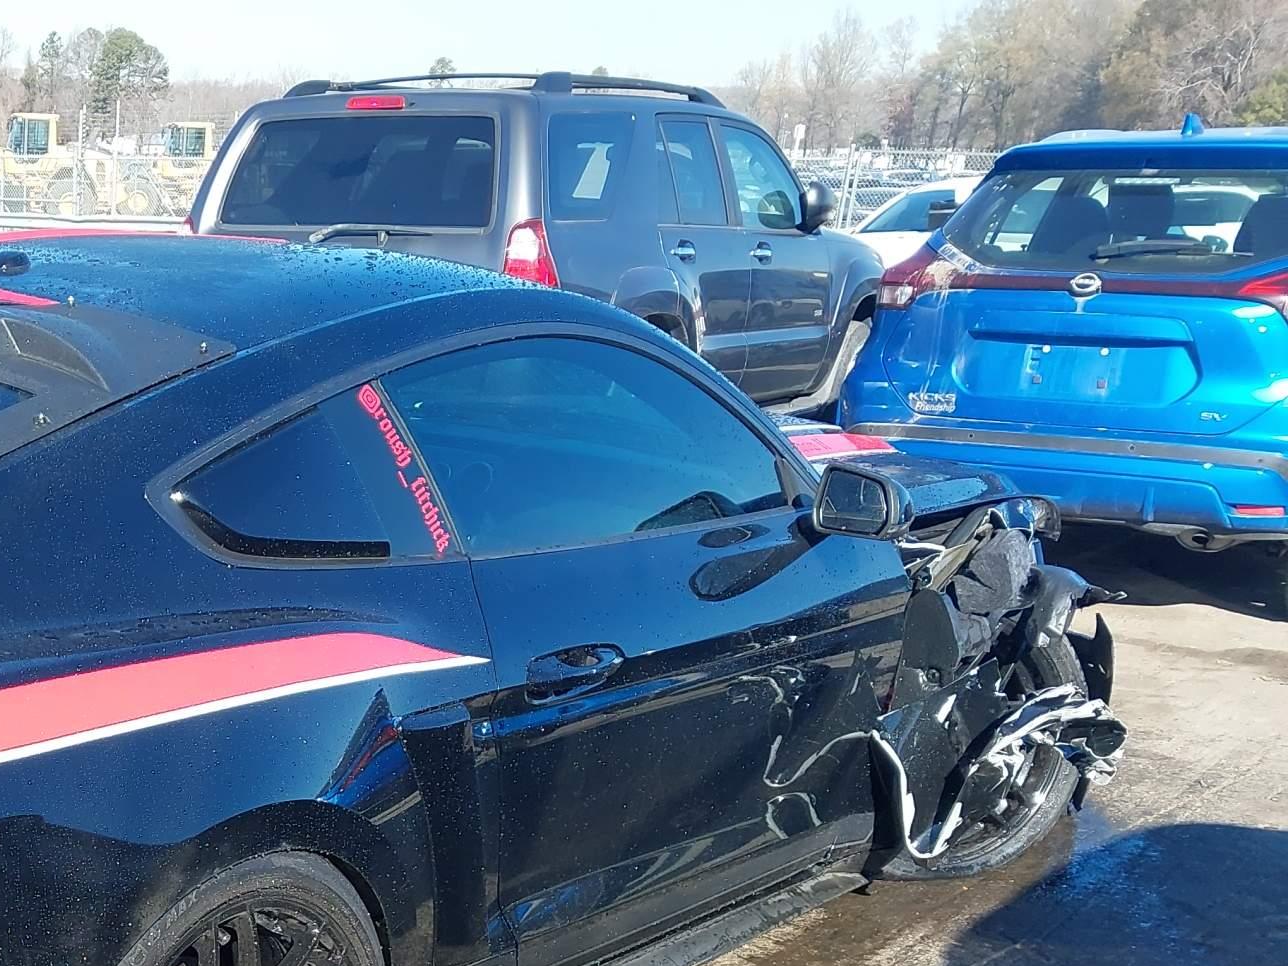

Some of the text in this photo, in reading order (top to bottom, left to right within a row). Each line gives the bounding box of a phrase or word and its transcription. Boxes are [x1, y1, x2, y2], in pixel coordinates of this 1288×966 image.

[909, 392, 956, 402] KICKS
[915, 401, 956, 413] Friendship
[1200, 411, 1228, 421] SV
